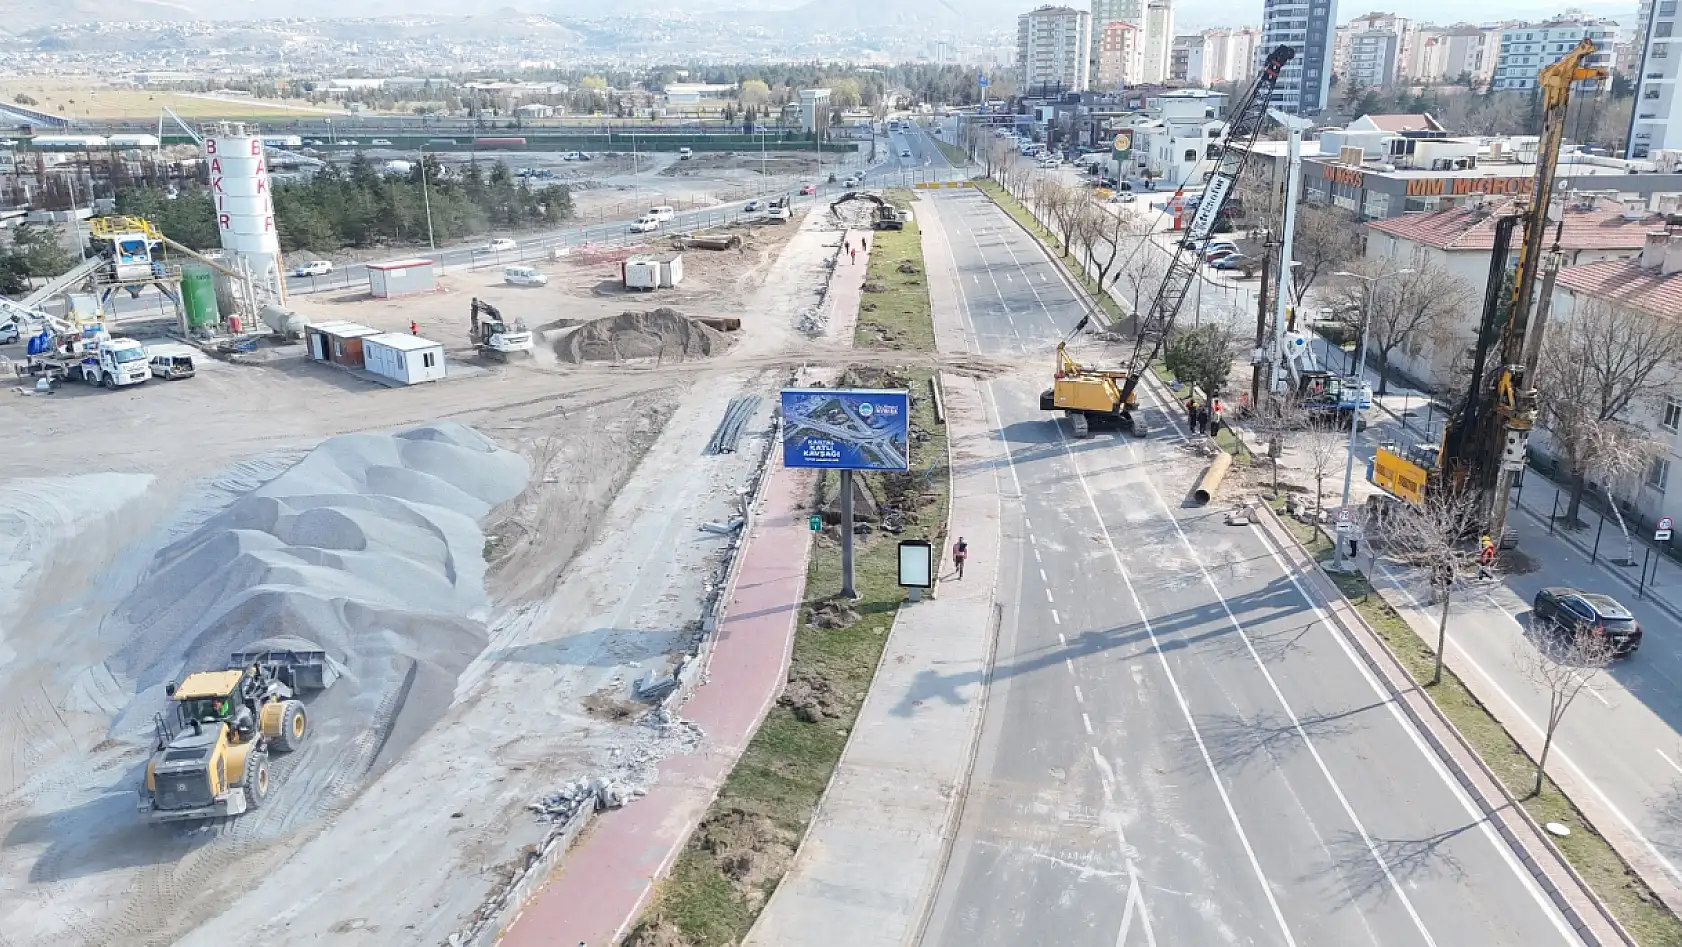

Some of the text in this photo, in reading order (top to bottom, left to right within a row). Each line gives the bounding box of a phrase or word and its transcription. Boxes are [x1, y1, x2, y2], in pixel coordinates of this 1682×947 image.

[206, 138, 230, 230] BAKIR
[1335, 168, 1362, 187] MIGROS
[1406, 178, 1533, 196] MM MIGROS
